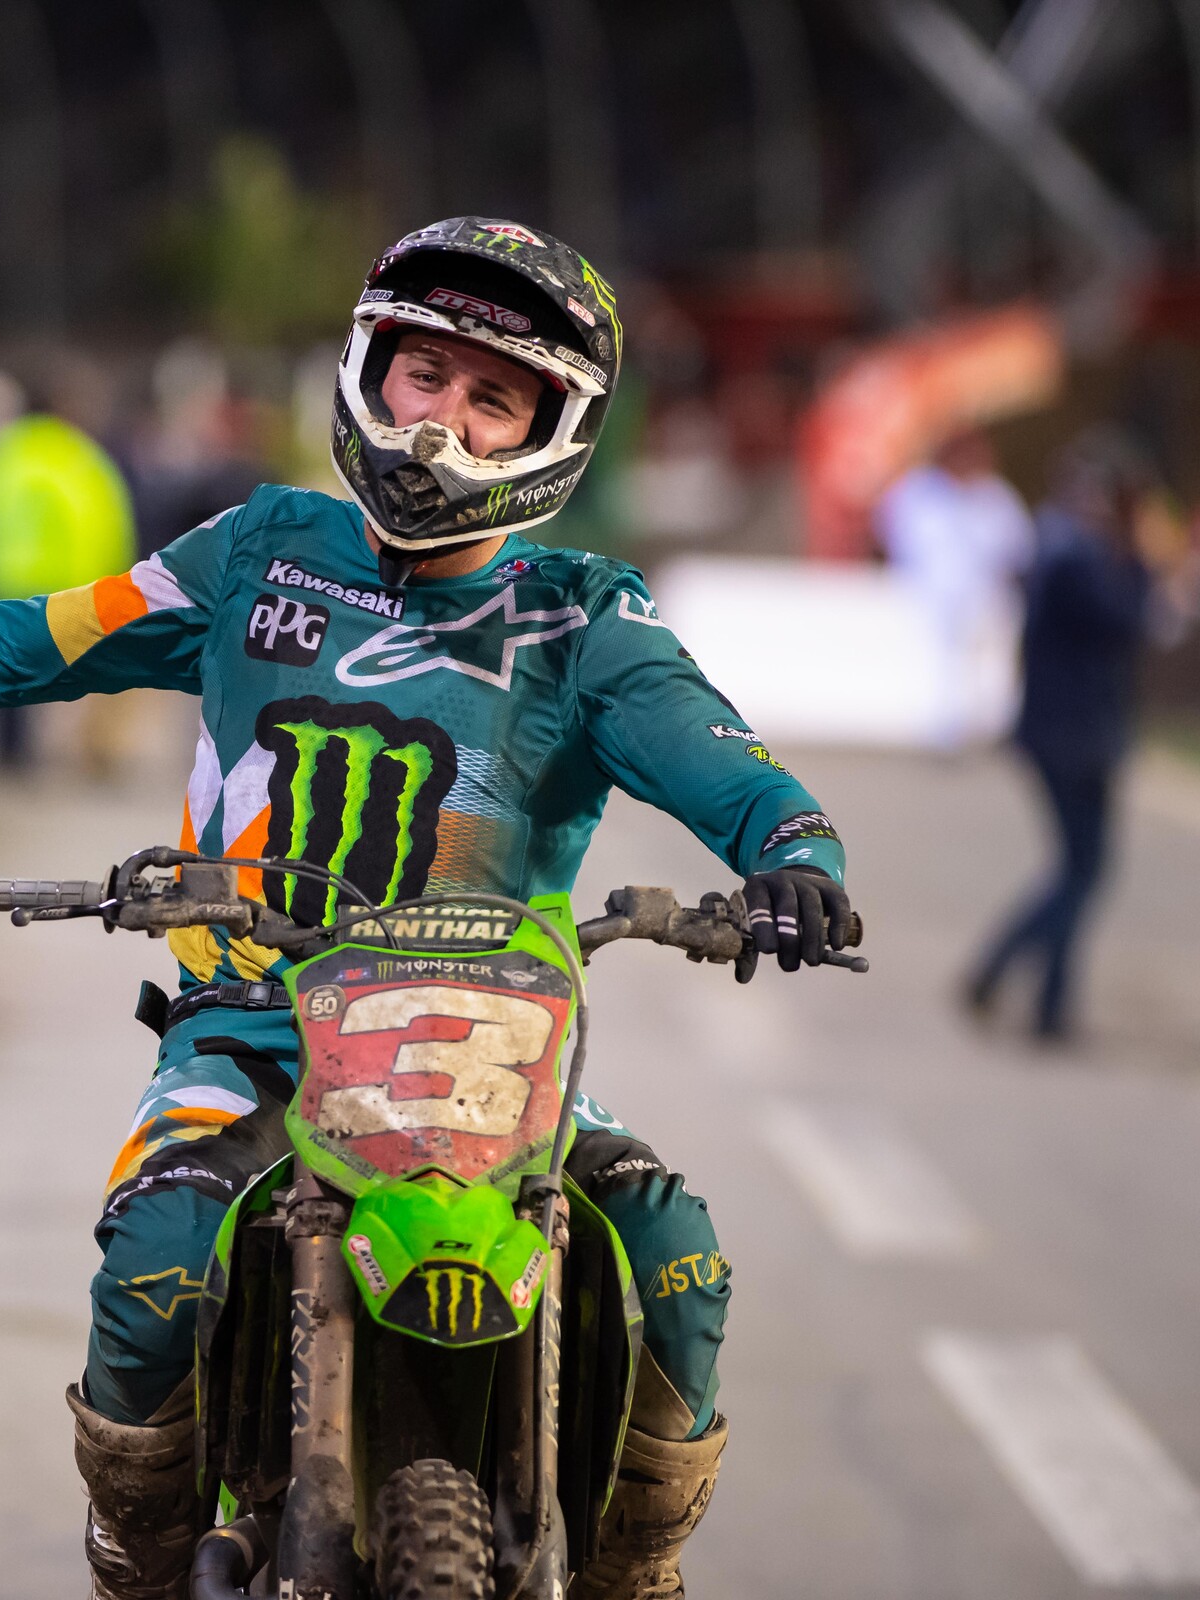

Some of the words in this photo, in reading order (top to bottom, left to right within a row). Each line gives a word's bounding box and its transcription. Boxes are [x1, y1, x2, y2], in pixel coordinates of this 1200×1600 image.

[555, 346, 607, 385] apdesigns
[517, 469, 581, 506] MONSTE
[267, 559, 404, 619] Kawasaki
[350, 919, 514, 940] RENTHAL
[311, 996, 338, 1016] 50
[317, 985, 555, 1138] 3
